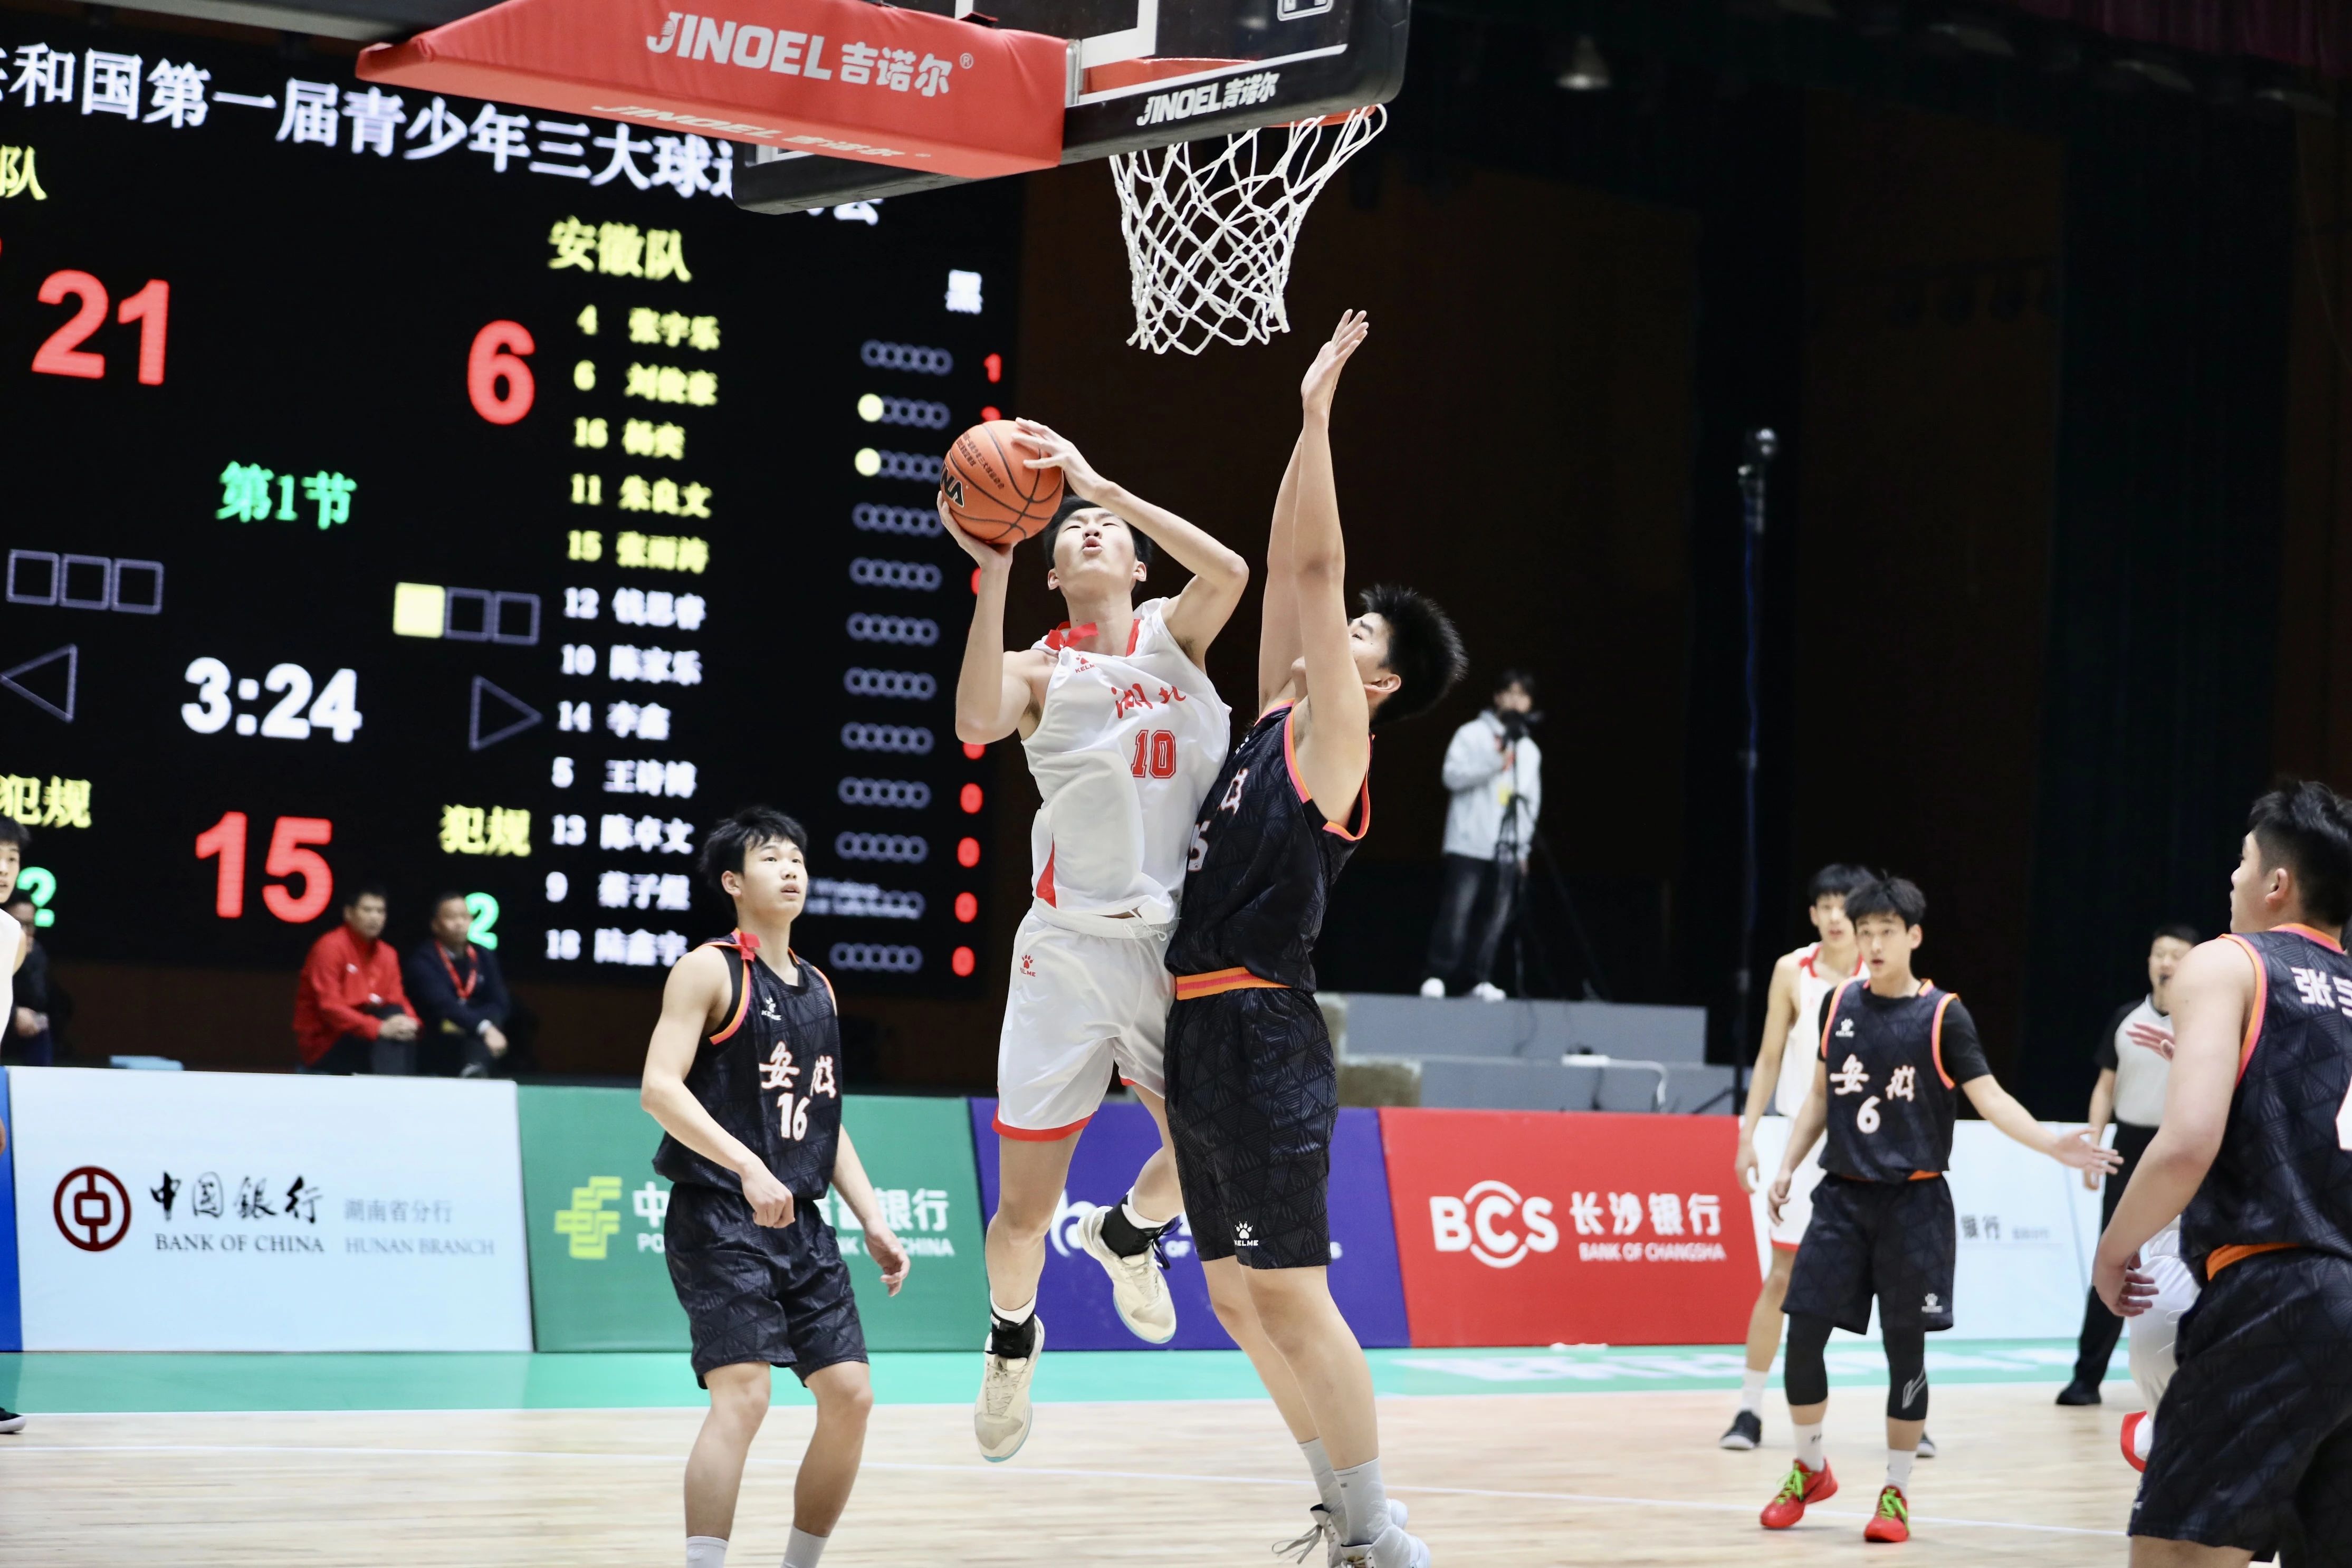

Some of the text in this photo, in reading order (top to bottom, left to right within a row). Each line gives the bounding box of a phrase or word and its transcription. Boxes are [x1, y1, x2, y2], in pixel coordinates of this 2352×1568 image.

[646, 11, 953, 97] JINOEL 吉诺尔
[1137, 72, 1280, 126] JINOEL 吉诺尔
[591, 106, 782, 139] JINOEL
[549, 215, 692, 283] 安徽队
[32, 269, 170, 386] 21
[577, 304, 597, 335] 4
[467, 320, 535, 425] 6
[574, 360, 595, 391] 6
[983, 352, 1002, 383] 1
[574, 417, 608, 448] 16
[216, 461, 358, 530] 第1节
[571, 474, 601, 505] 11
[568, 530, 602, 561] 15
[564, 587, 599, 619] 12
[561, 644, 596, 675] 10
[1075, 663, 1096, 673] KELM
[181, 657, 363, 743] 3:24
[558, 701, 592, 732] 14
[1131, 730, 1176, 779] 10
[551, 756, 574, 788] 5
[0, 774, 92, 828] 犯规
[439, 804, 531, 857] 犯规
[552, 814, 587, 846] 13
[195, 811, 333, 923] 15
[546, 871, 568, 902] 9
[467, 892, 500, 949] 2
[546, 929, 581, 960] 18
[777, 1093, 810, 1141] 16
[1857, 1095, 1881, 1134] 6
[1429, 1196, 1559, 1254] BCS
[1569, 1192, 1721, 1236] 长沙银行
[156, 1232, 324, 1253] BANK OF CHINA
[345, 1236, 495, 1256] HUNAN BRANCH
[1578, 1242, 1726, 1261] BANK OF CHANGSHA
